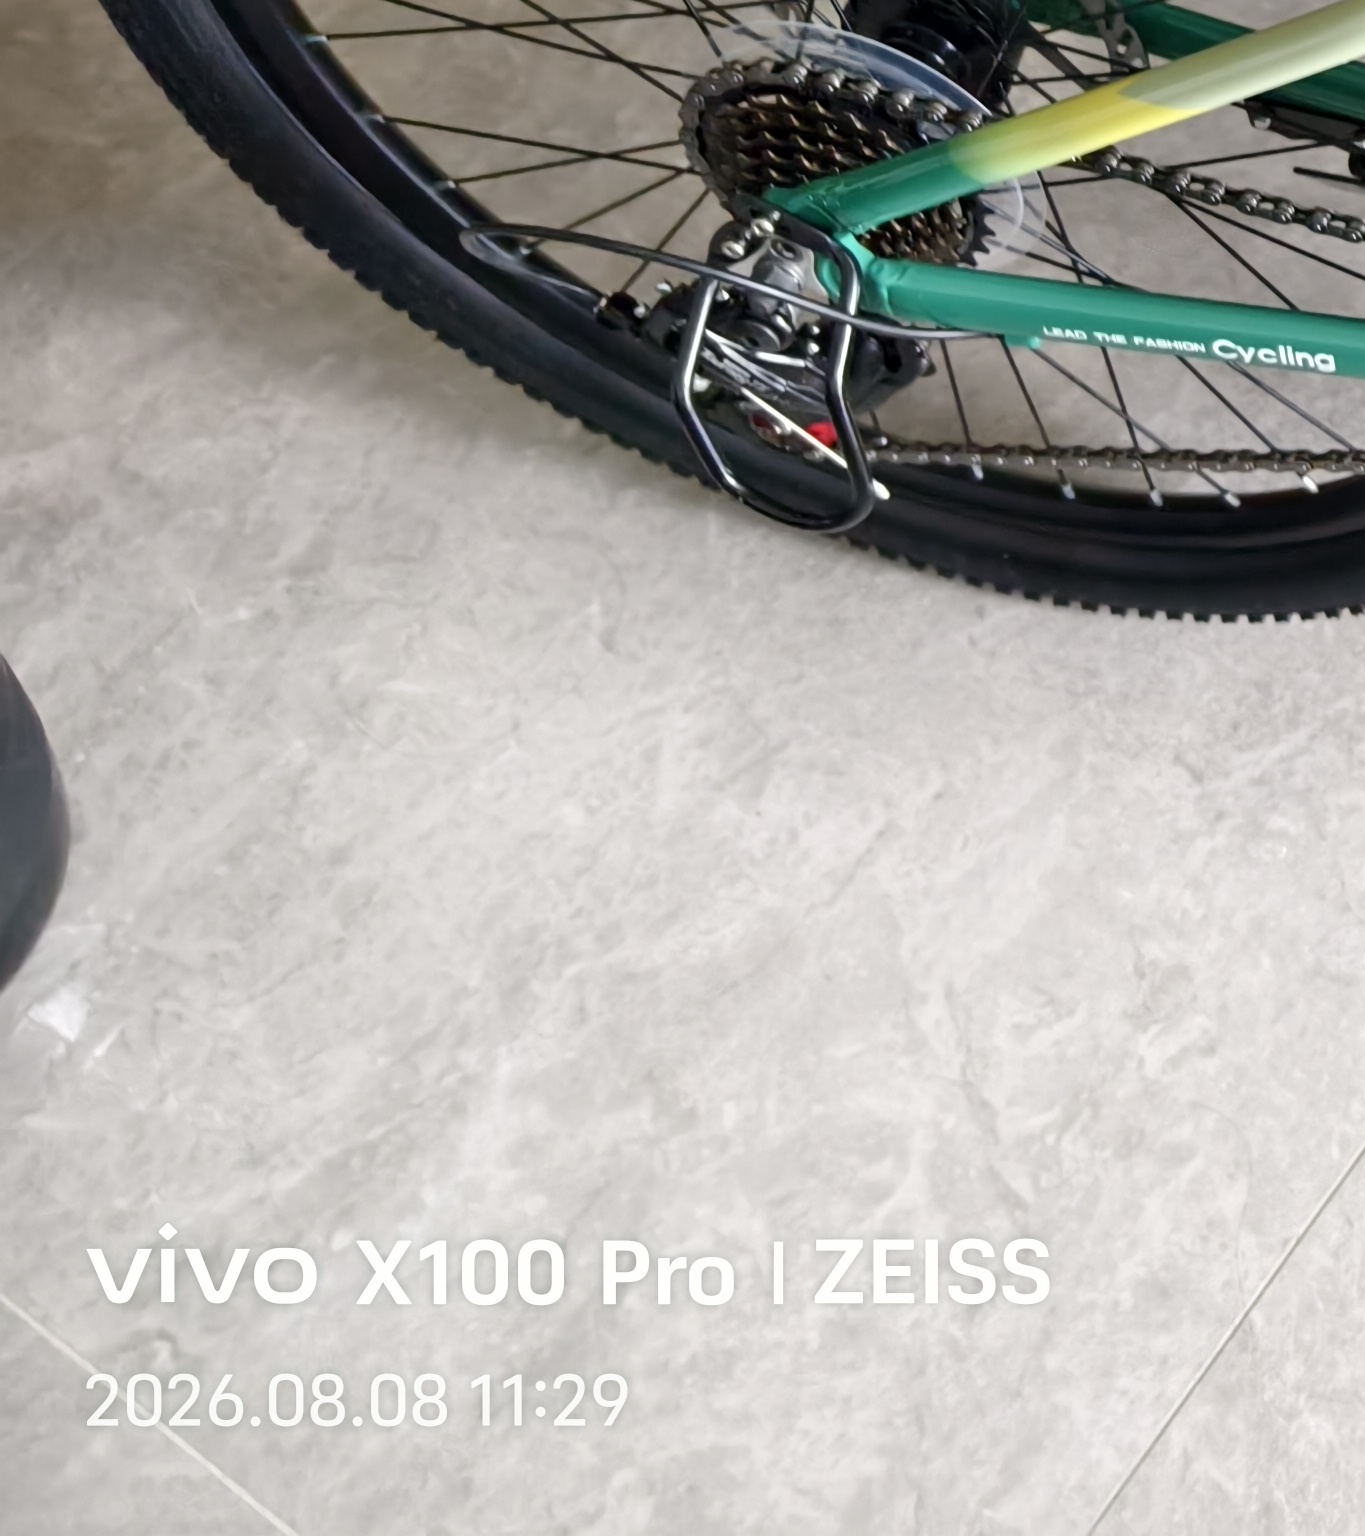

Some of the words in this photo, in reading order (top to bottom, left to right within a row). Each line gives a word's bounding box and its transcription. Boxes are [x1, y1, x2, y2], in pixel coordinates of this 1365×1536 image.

[1043, 326, 1088, 341] LEAD
[1093, 331, 1127, 346] THE
[1133, 335, 1206, 354] FASHION
[1212, 338, 1337, 373] Cycling
